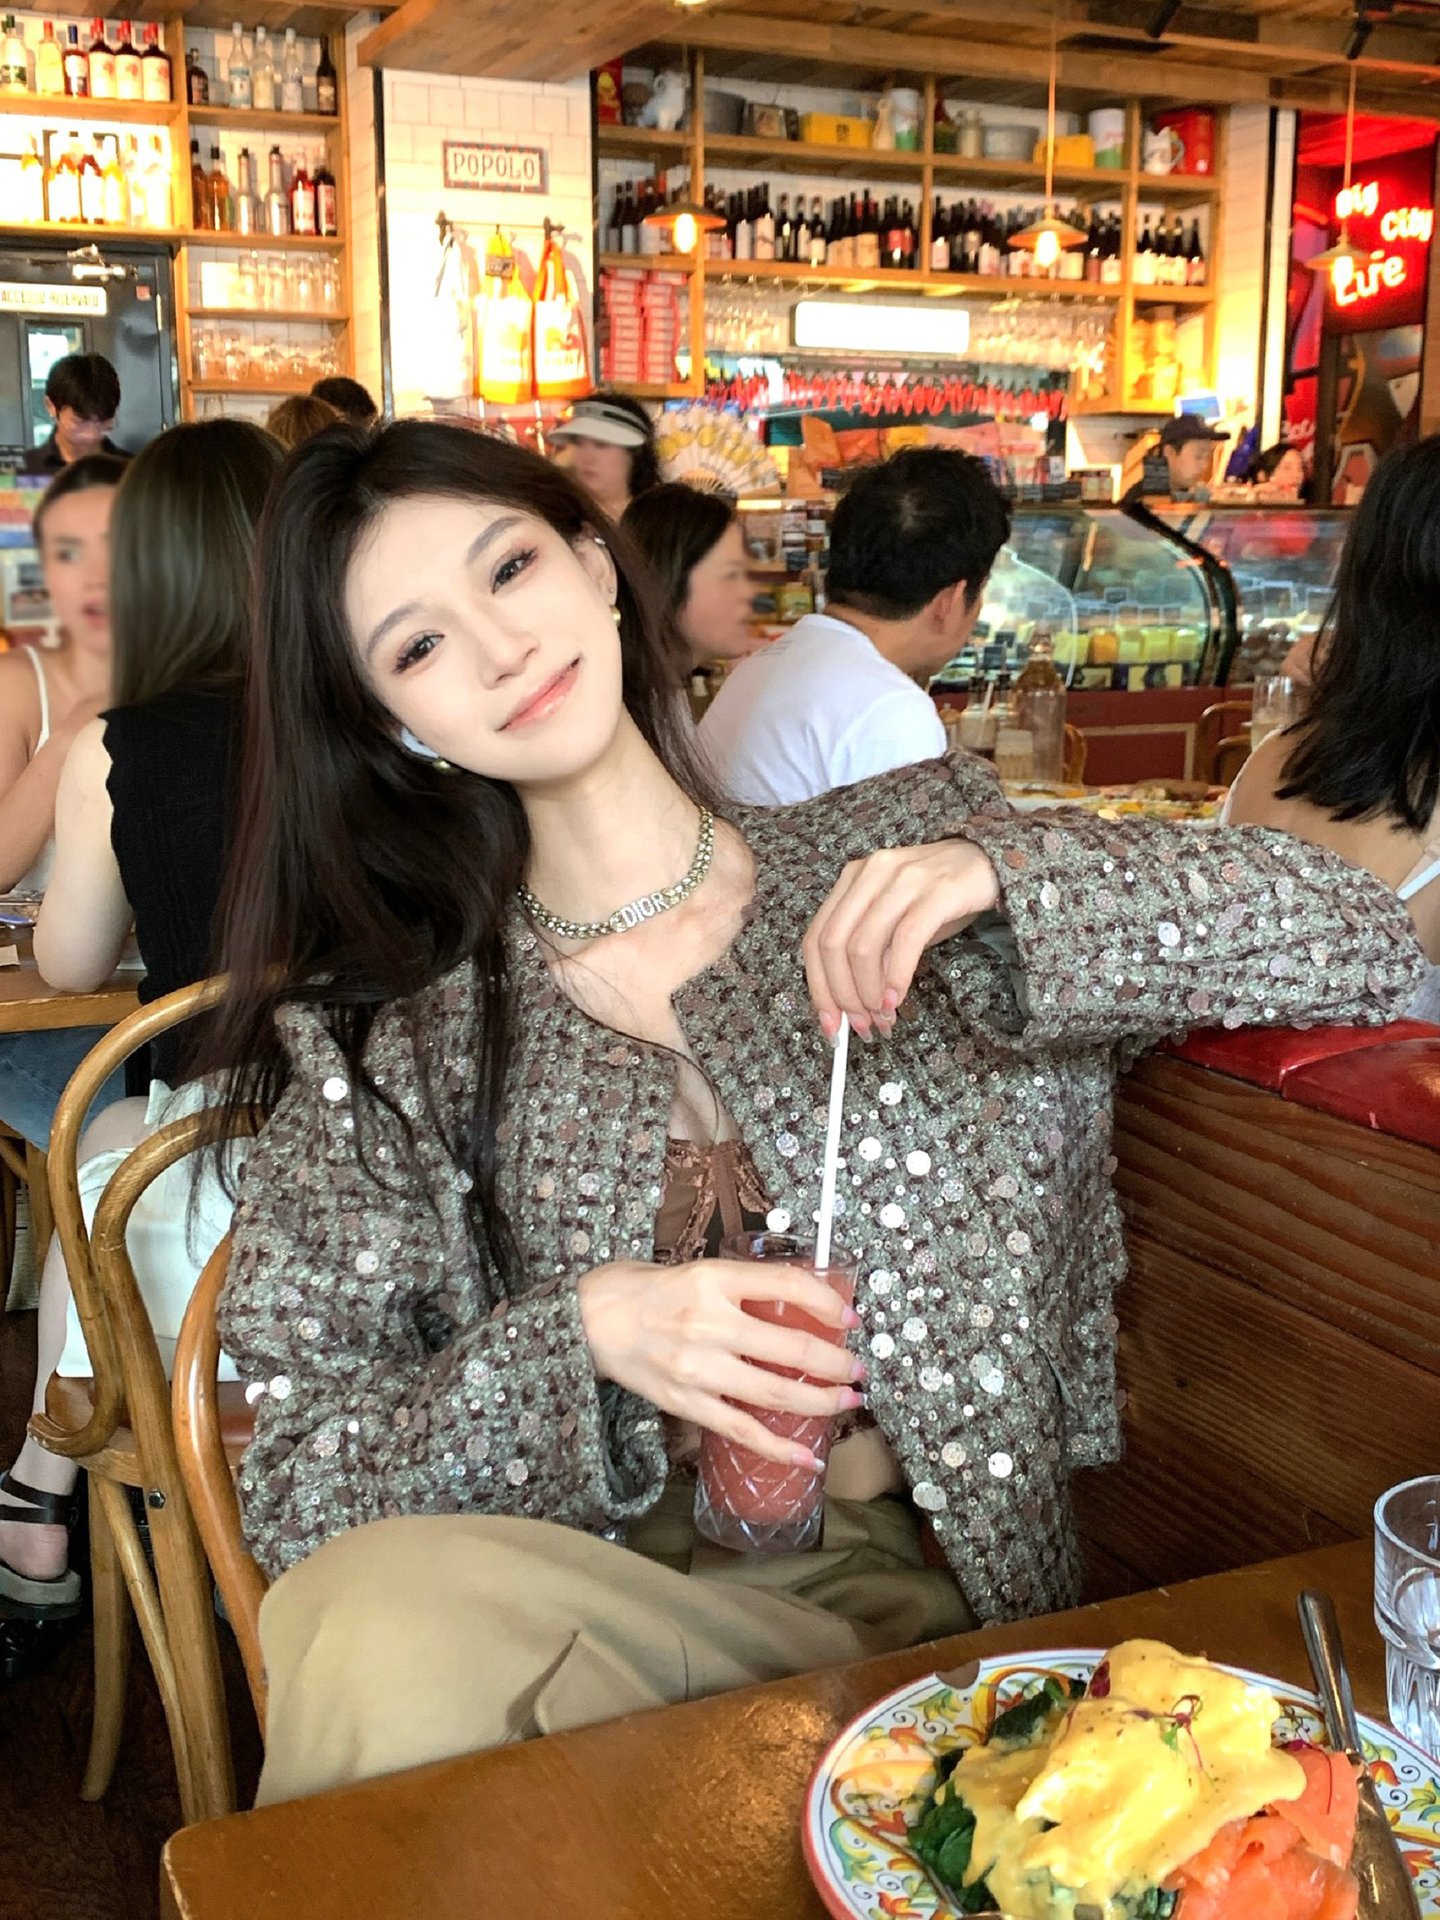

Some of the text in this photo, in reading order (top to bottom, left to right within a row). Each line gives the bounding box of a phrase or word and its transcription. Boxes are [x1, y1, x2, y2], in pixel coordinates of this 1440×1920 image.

[453, 152, 535, 180] POPOLO
[1, 289, 46, 305] ACCEO
[620, 892, 671, 929] DIOR
